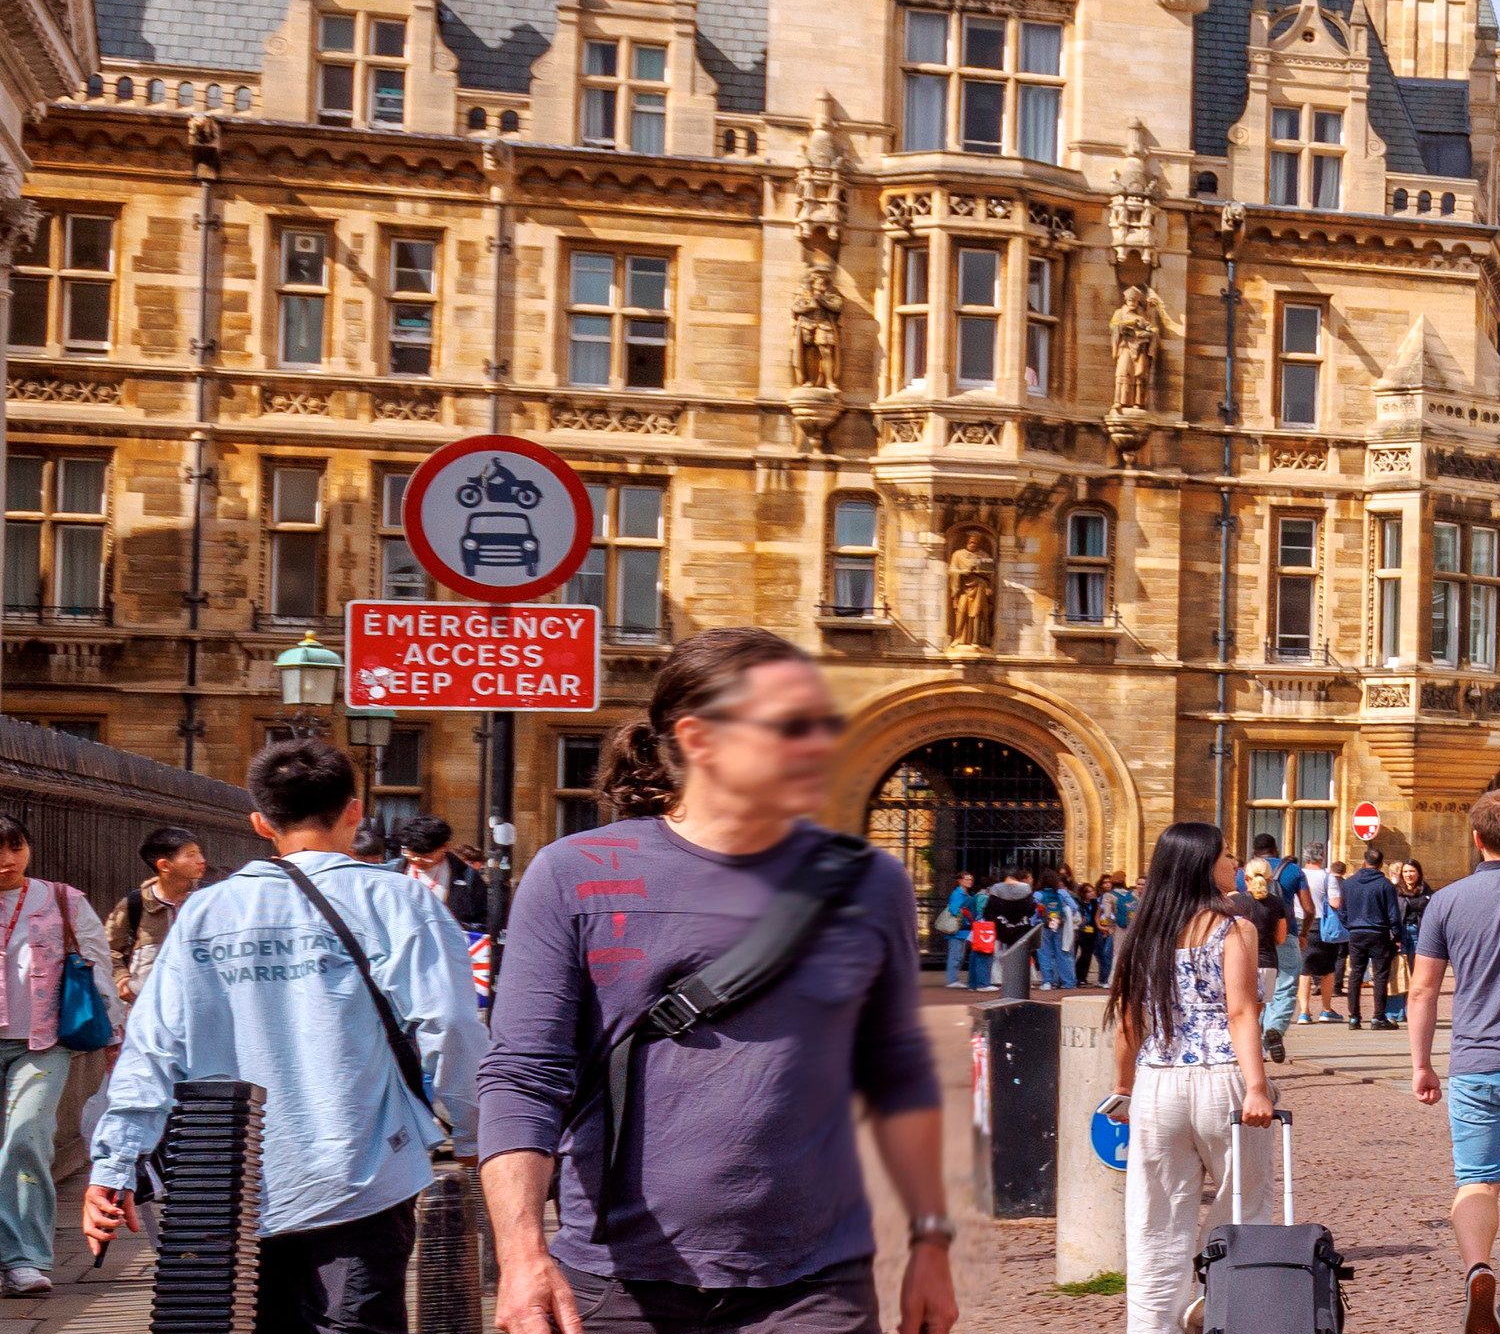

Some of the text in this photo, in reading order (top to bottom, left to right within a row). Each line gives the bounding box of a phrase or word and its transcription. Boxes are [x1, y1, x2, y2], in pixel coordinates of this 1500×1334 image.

[363, 613, 586, 639] EMERGENCY
[402, 643, 544, 667] ACCESS
[361, 669, 581, 696] EEP CLEAR
[192, 939, 294, 964] GOLDEN
[220, 958, 328, 986] WARRIRS
